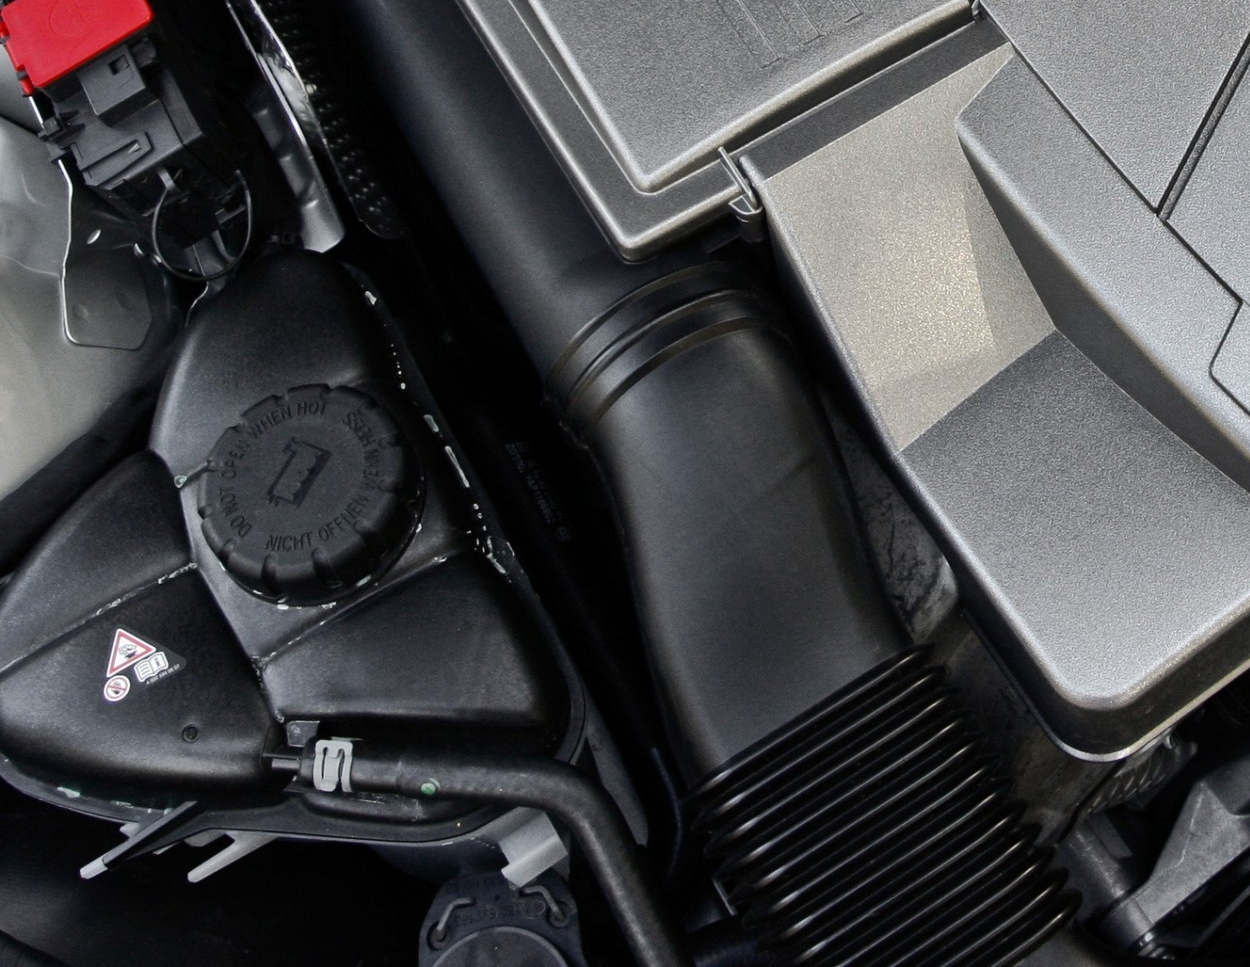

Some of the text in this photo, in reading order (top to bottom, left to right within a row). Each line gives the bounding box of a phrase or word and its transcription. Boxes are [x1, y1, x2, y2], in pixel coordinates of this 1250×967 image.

[218, 401, 328, 540] DO NOT OPEN WHEN HOT
[263, 530, 314, 552] NICHT
